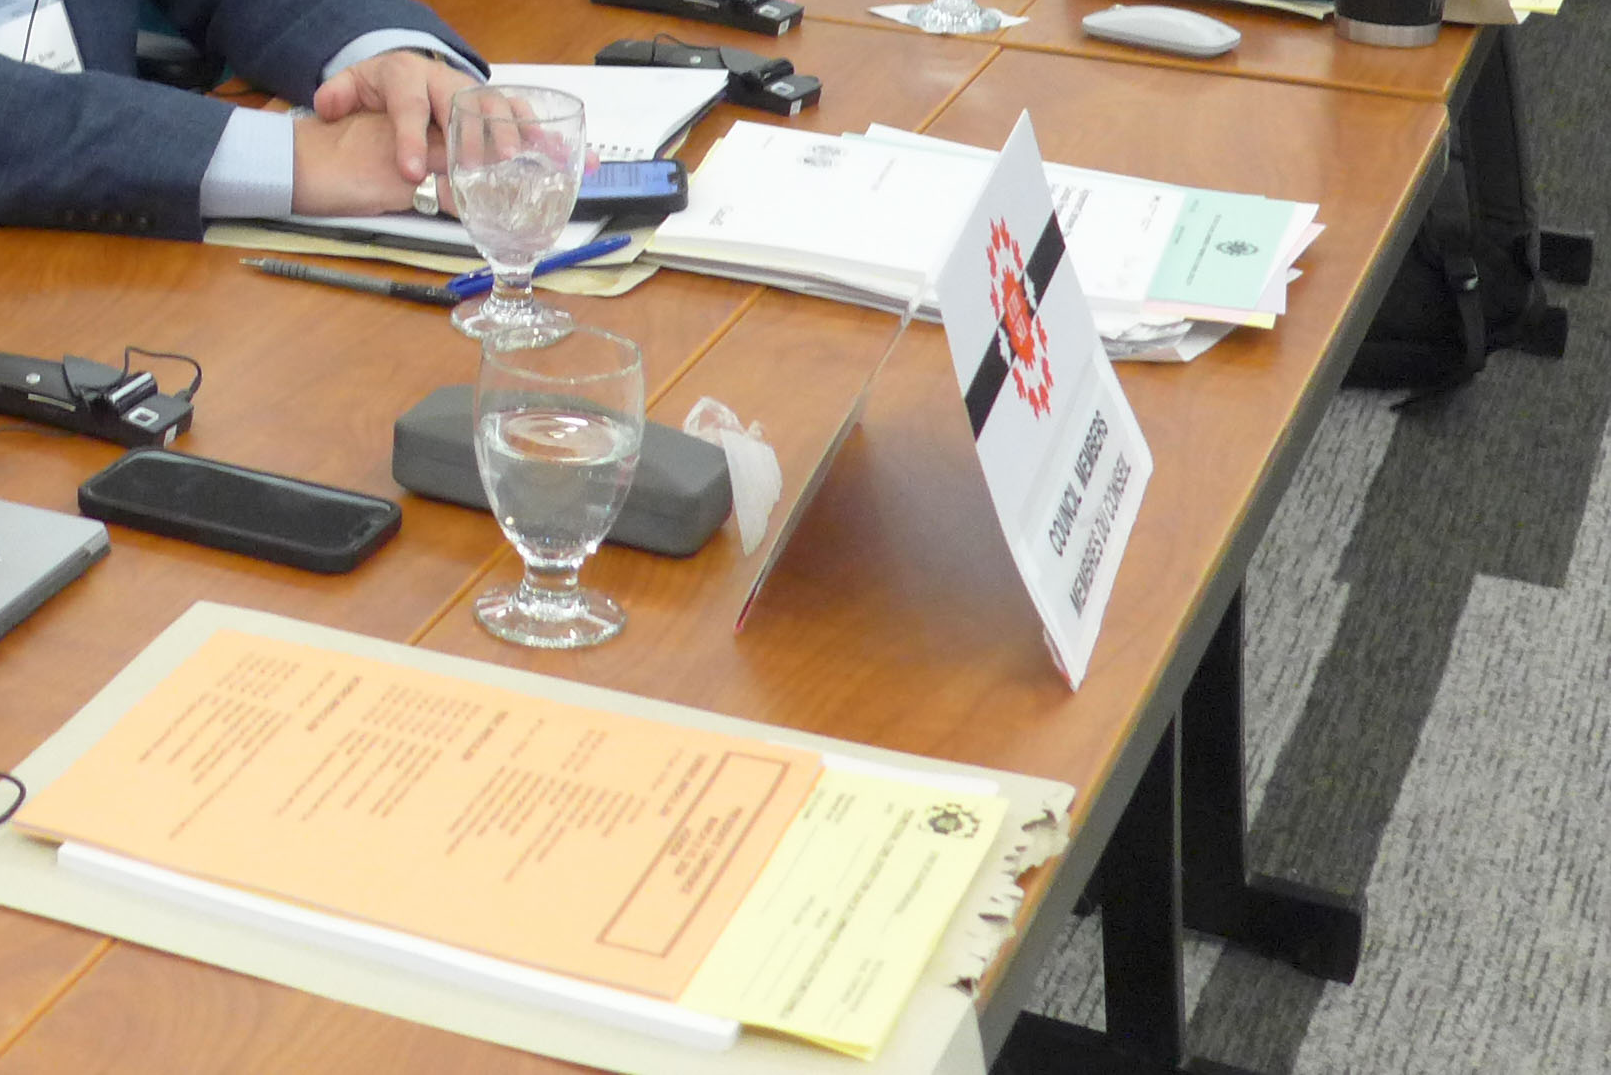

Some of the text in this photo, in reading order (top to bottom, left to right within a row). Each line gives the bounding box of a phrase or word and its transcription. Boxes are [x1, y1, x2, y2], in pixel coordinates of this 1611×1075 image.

[1048, 409, 1109, 558] COUNCIL MEMBERS
[1069, 450, 1132, 620] MEMBRES DU CONSEIL
